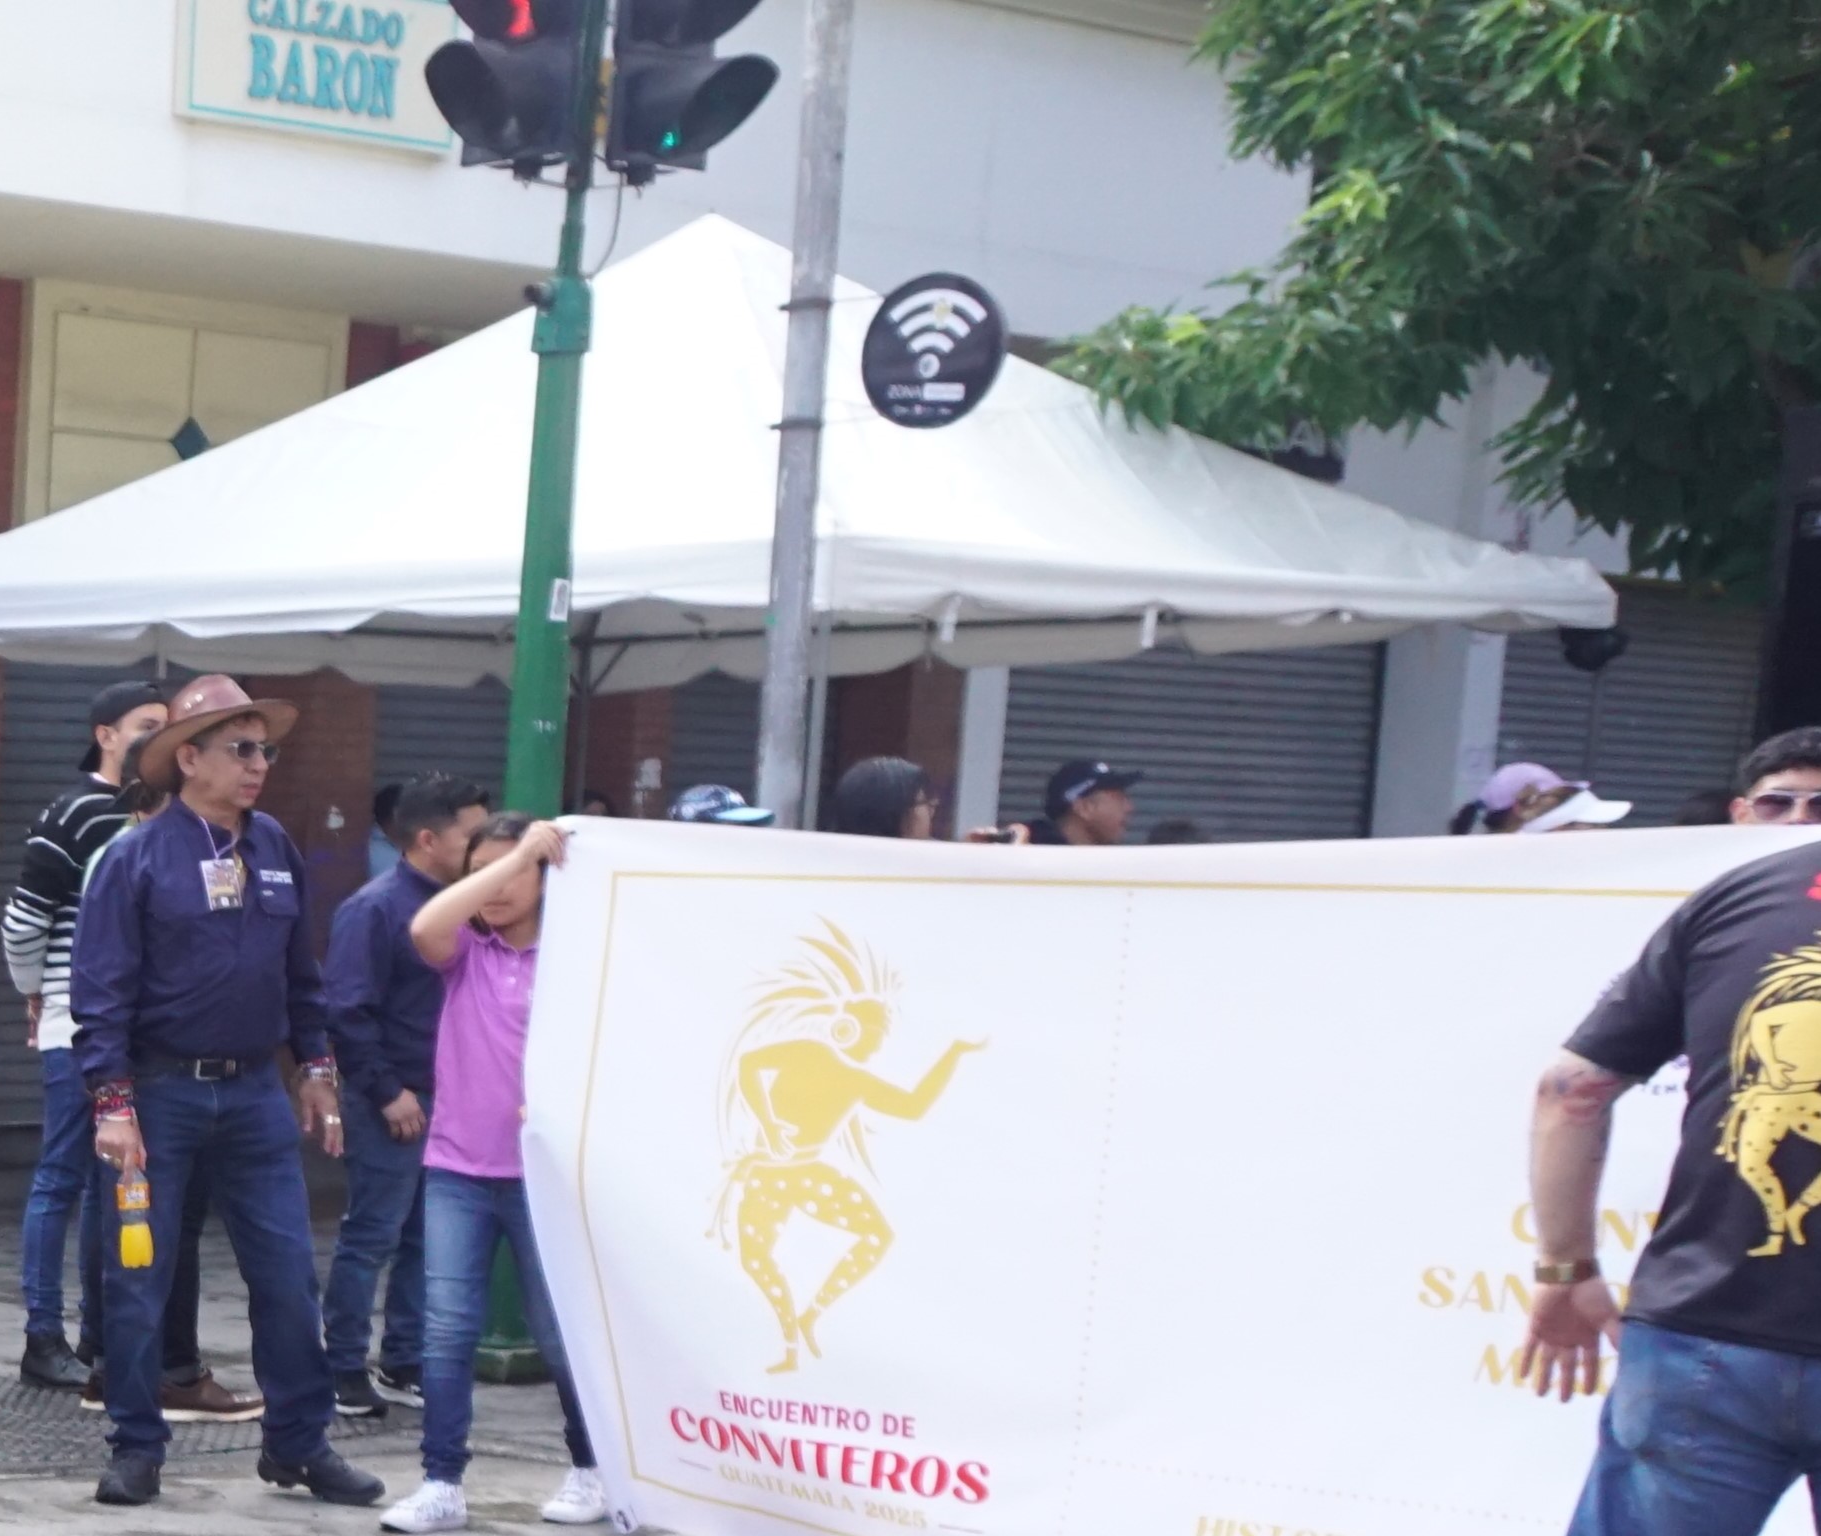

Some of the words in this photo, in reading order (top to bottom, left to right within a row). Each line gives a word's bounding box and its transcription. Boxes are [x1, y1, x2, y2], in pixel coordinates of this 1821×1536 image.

[248, 0, 405, 47] CALZADO
[248, 33, 400, 119] BARON
[718, 1389, 871, 1433] ENCUENTRO
[882, 1412, 917, 1440] DE
[669, 1405, 991, 1505] CONVITEROS
[718, 1463, 856, 1514] GUATEMALA
[863, 1500, 929, 1530] 2025
